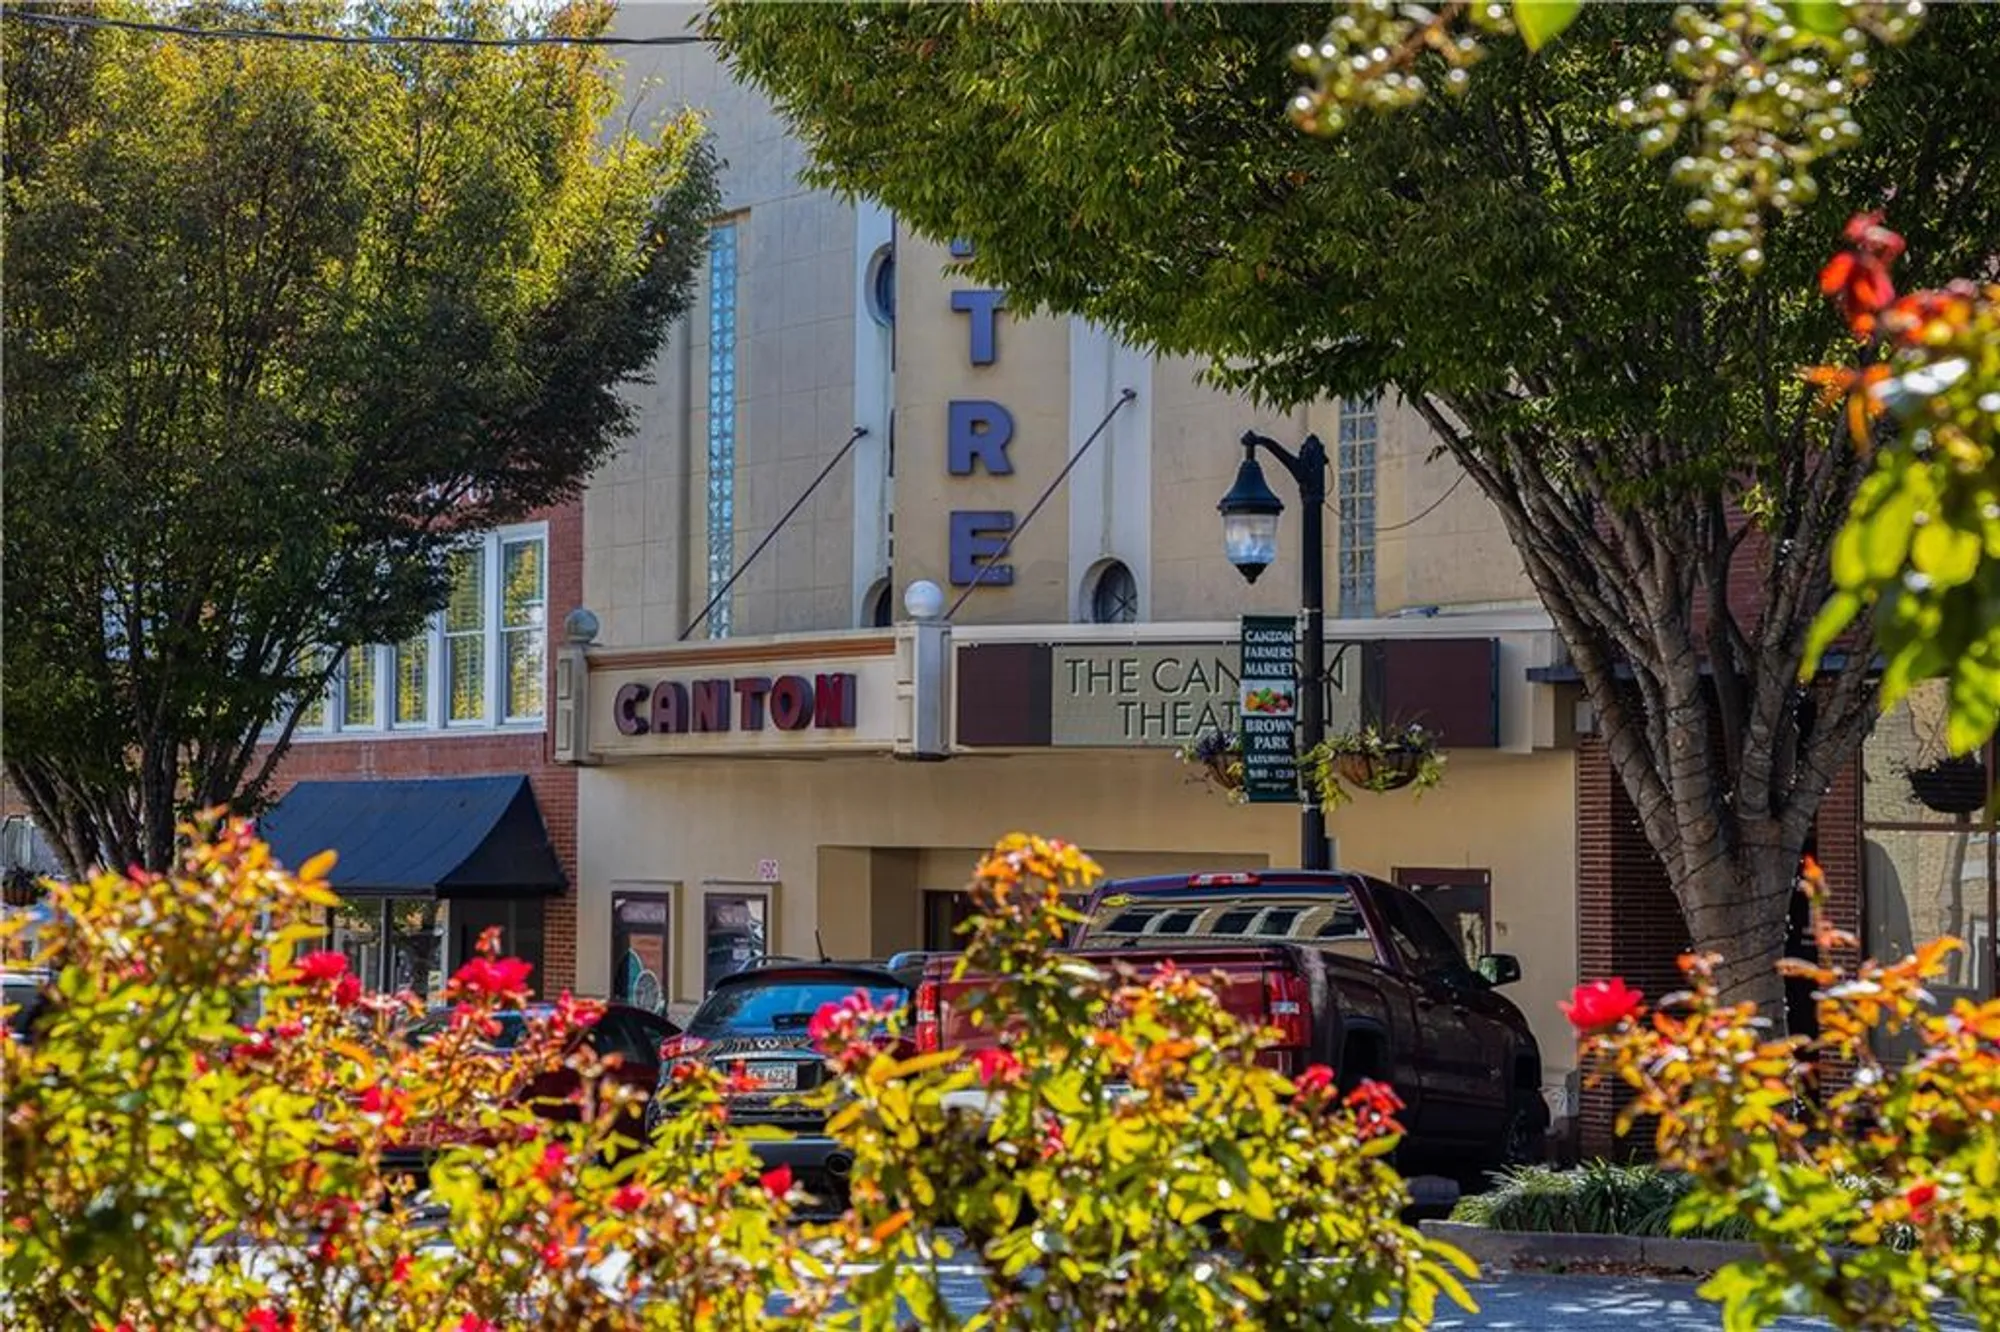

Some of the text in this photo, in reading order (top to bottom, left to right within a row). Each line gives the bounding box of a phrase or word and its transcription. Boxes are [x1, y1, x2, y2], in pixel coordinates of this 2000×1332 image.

[947, 234, 1015, 587] TRE
[1244, 646, 1294, 660] FARMERS
[1066, 658, 1346, 696] THE CANN
[1244, 661, 1294, 677] MARKET
[614, 672, 857, 736] CANTON
[1245, 719, 1294, 734] BROWN
[1253, 736, 1290, 750] PARK
